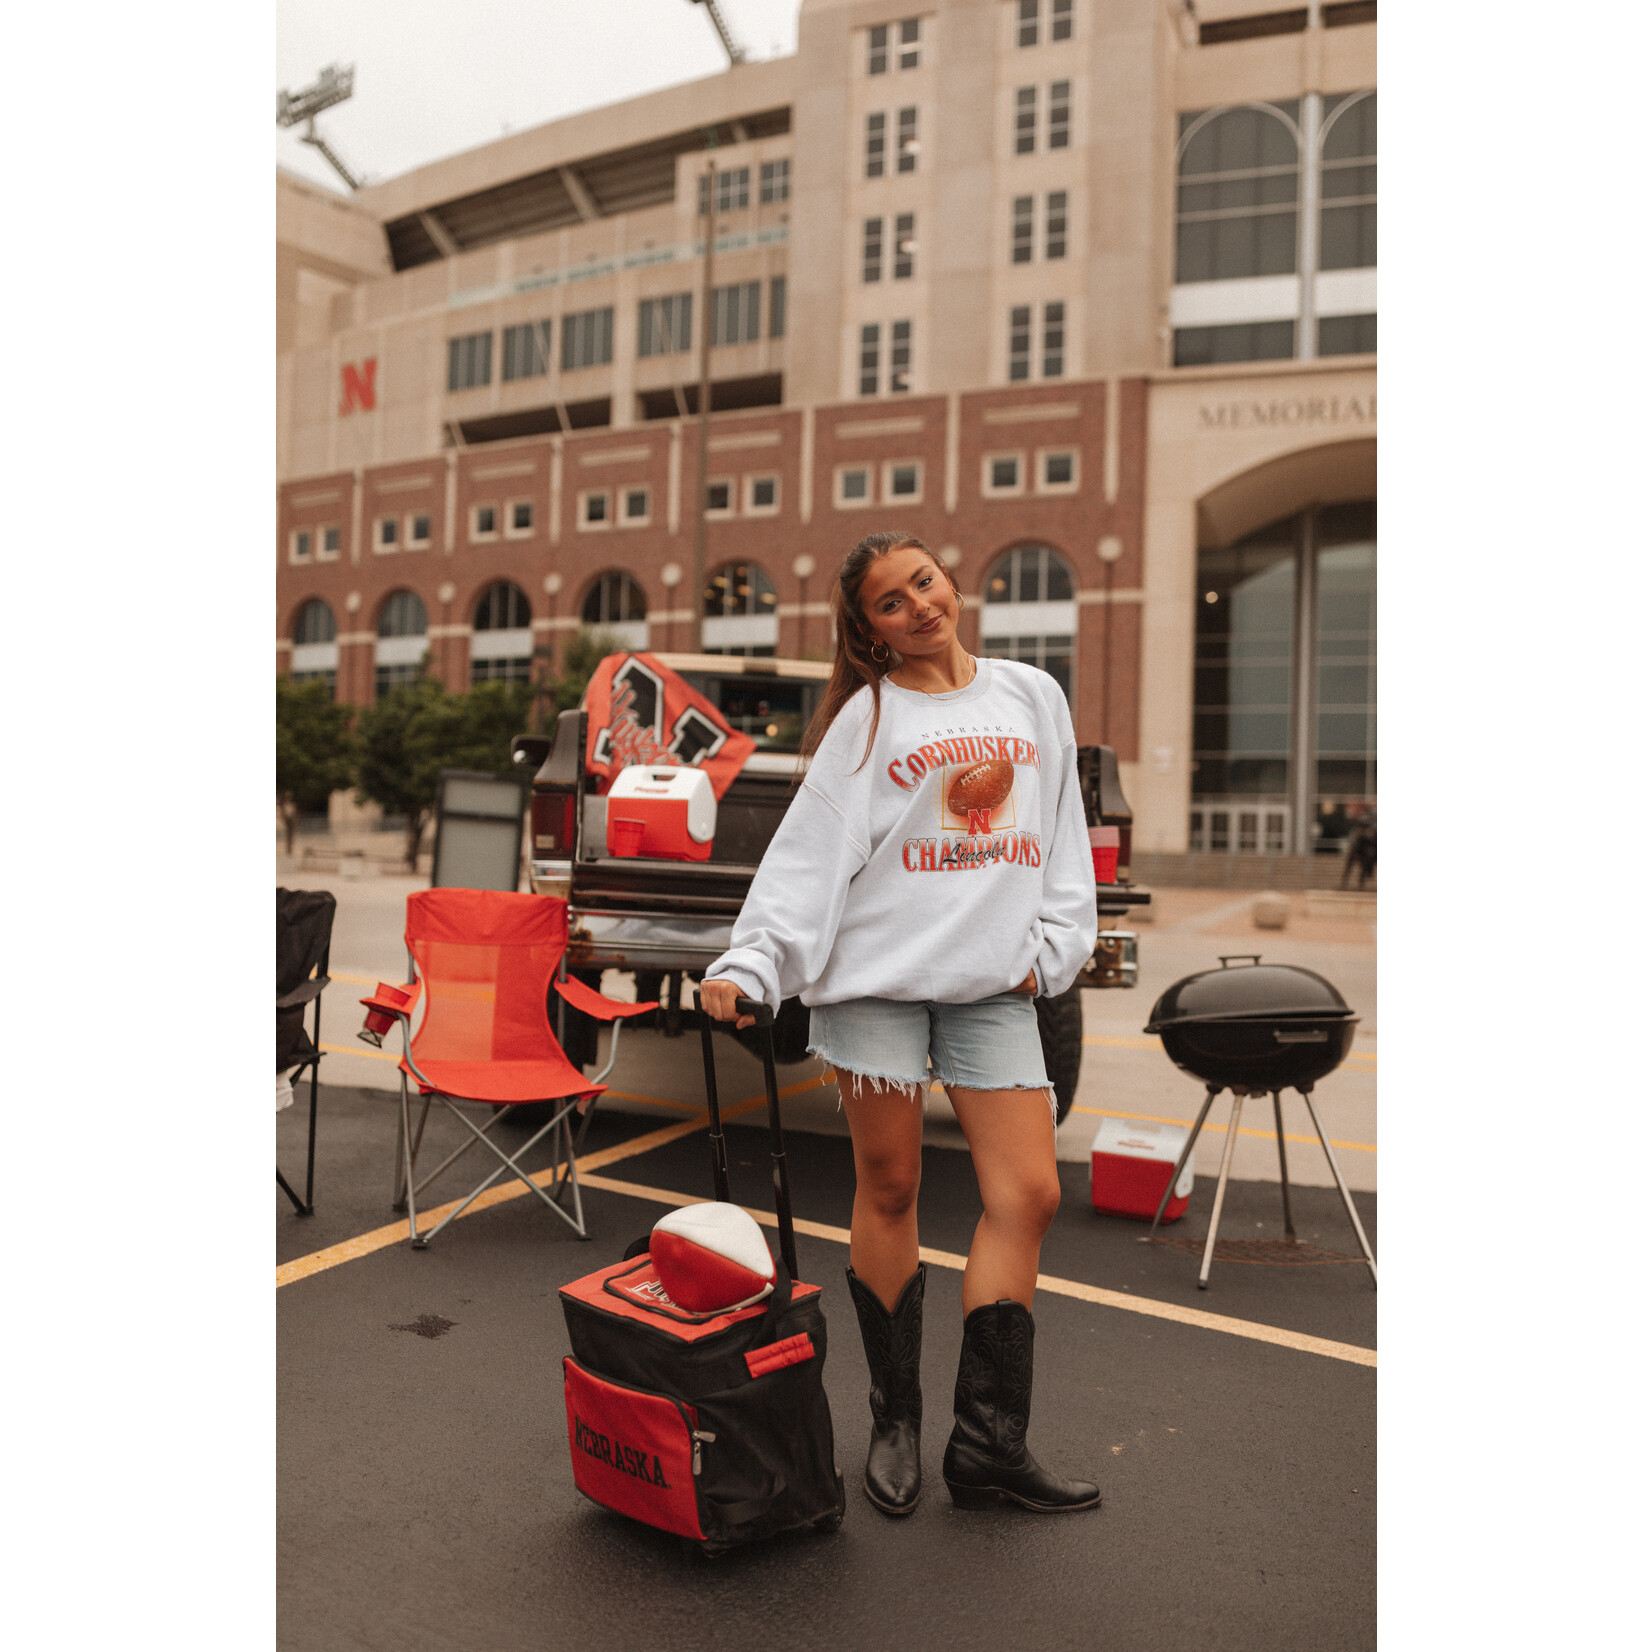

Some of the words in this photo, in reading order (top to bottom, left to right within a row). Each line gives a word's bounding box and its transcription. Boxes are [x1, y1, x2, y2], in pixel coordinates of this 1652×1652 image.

[339, 357, 377, 417] N
[921, 725, 1017, 740] NEBRASKA
[967, 808, 992, 836] N
[902, 831, 1041, 873] CHAMPIONS
[942, 841, 1006, 864] Lincoln
[574, 1414, 669, 1489] NEBRASKA
